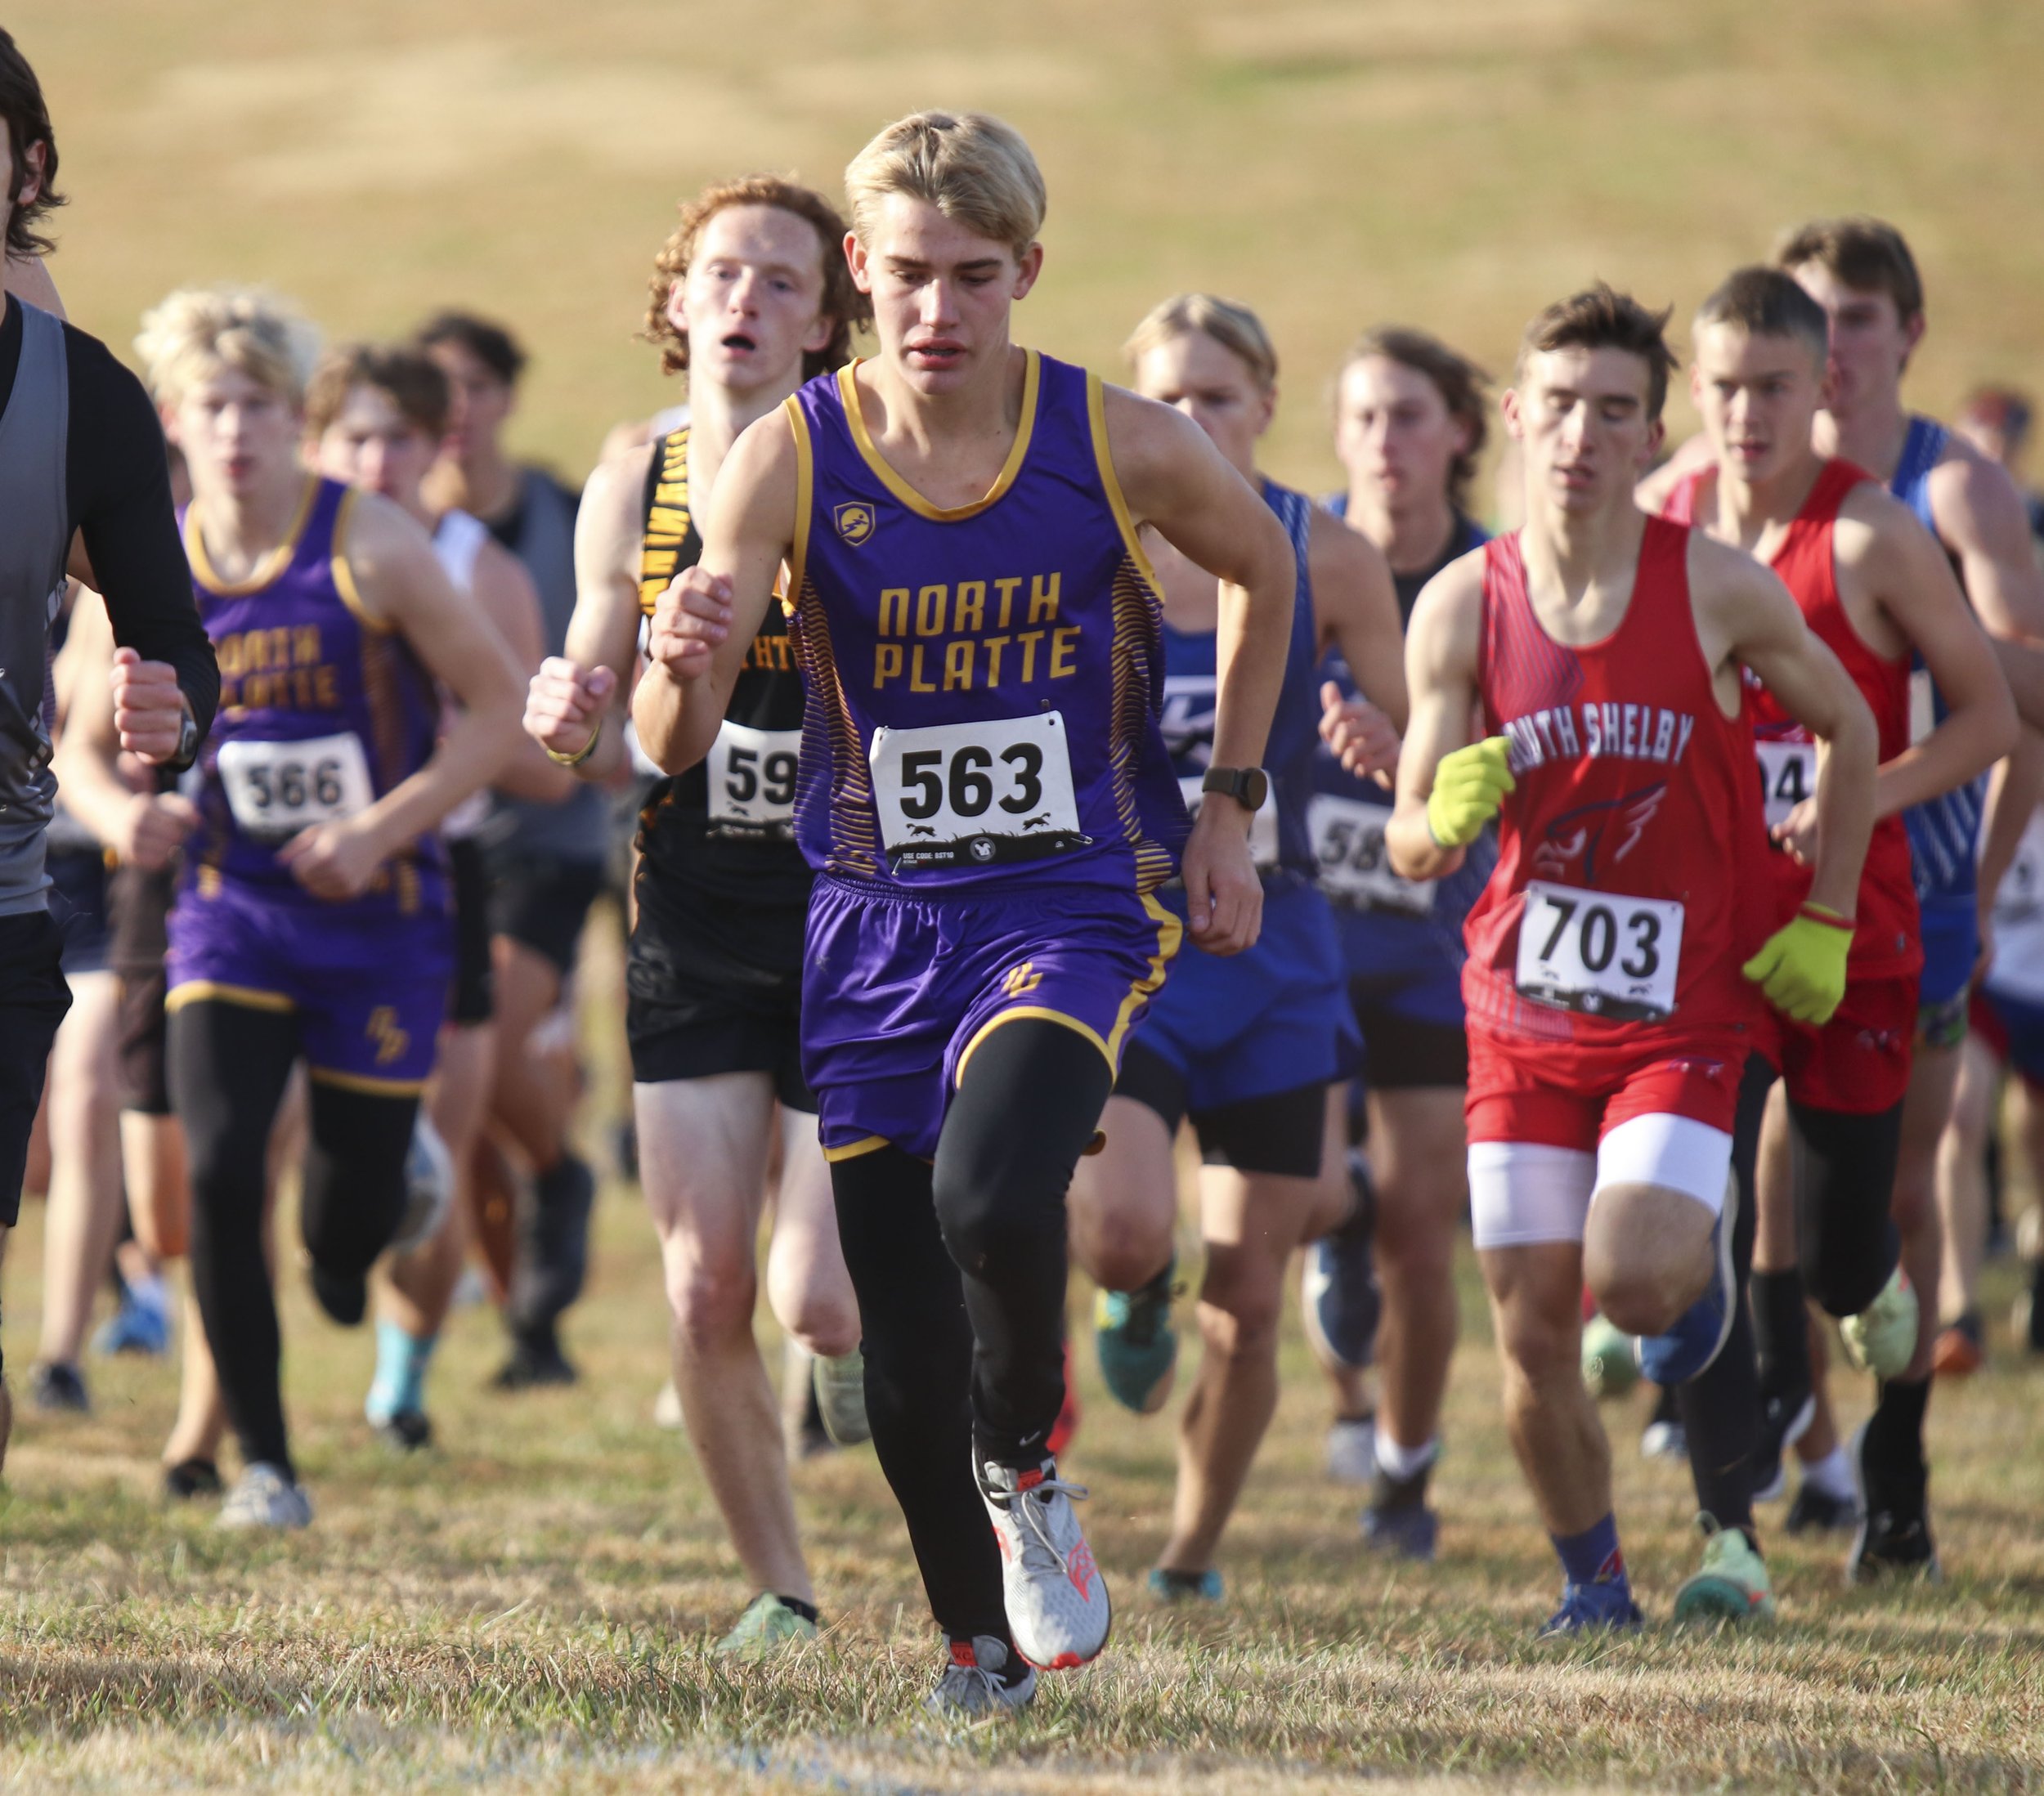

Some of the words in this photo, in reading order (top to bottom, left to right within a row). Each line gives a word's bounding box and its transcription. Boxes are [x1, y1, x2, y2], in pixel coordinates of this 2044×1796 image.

[878, 571, 1061, 637] NORTH
[873, 625, 1081, 692] PLATTE
[1503, 705, 1580, 773] OUTH
[1582, 702, 1694, 767] SHELBY
[247, 758, 343, 808] 566
[900, 742, 1043, 819] 563
[1319, 817, 1388, 872] 58
[1539, 894, 1661, 978] 703
